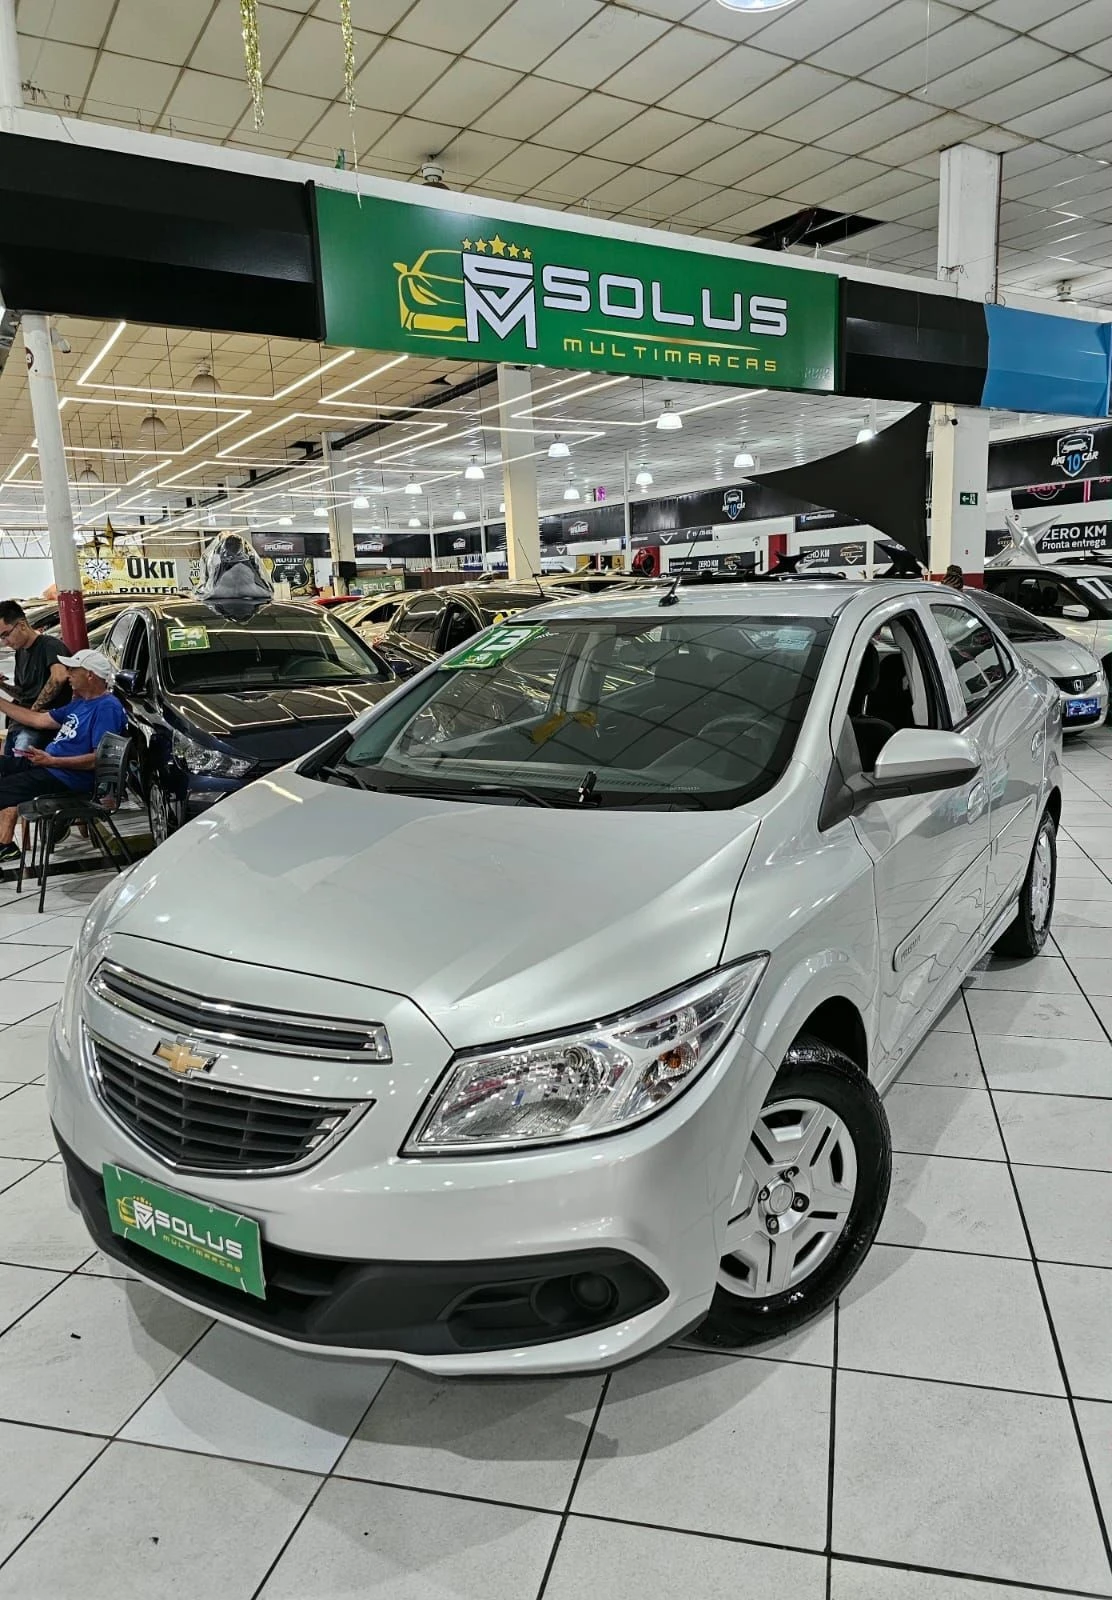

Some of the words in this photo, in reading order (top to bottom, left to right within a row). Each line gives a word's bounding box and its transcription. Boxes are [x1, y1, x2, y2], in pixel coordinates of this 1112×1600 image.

[541, 264, 788, 337] SOLUS
[563, 338, 777, 372] MULTIMARCAS
[1067, 453, 1081, 472] 10
[1081, 451, 1099, 461] CAR
[1042, 527, 1080, 541] ZERO
[1084, 525, 1107, 538] KM
[1042, 541, 1070, 550] Pronta
[1071, 538, 1106, 549] entrega
[474, 629, 532, 651] 13
[154, 1208, 243, 1260] SOLUS
[162, 1234, 241, 1273] MULTIMARCAS
